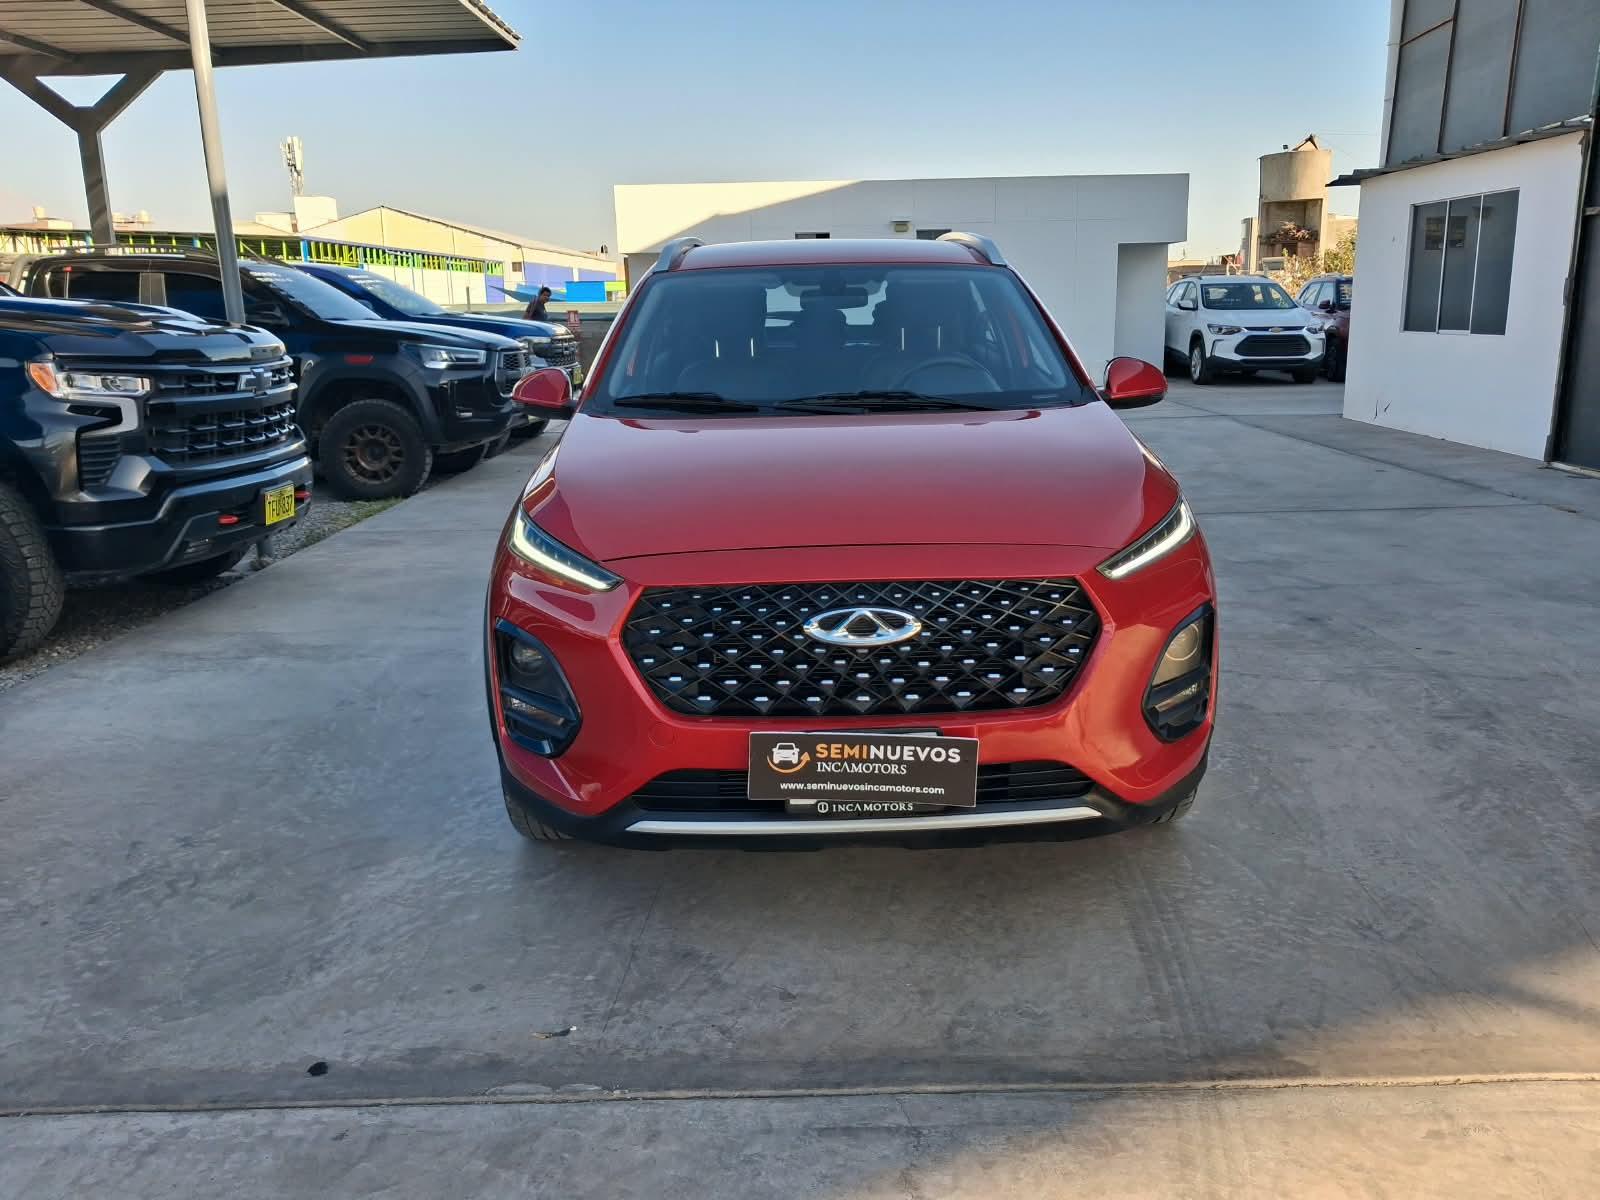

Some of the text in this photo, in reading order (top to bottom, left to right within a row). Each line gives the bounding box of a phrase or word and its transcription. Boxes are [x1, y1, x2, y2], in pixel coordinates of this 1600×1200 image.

[815, 743, 961, 763] SEMINUEVOS
[816, 761, 907, 774] INCAMOTORS
[780, 781, 945, 795] www.seminuevosincamotors.com
